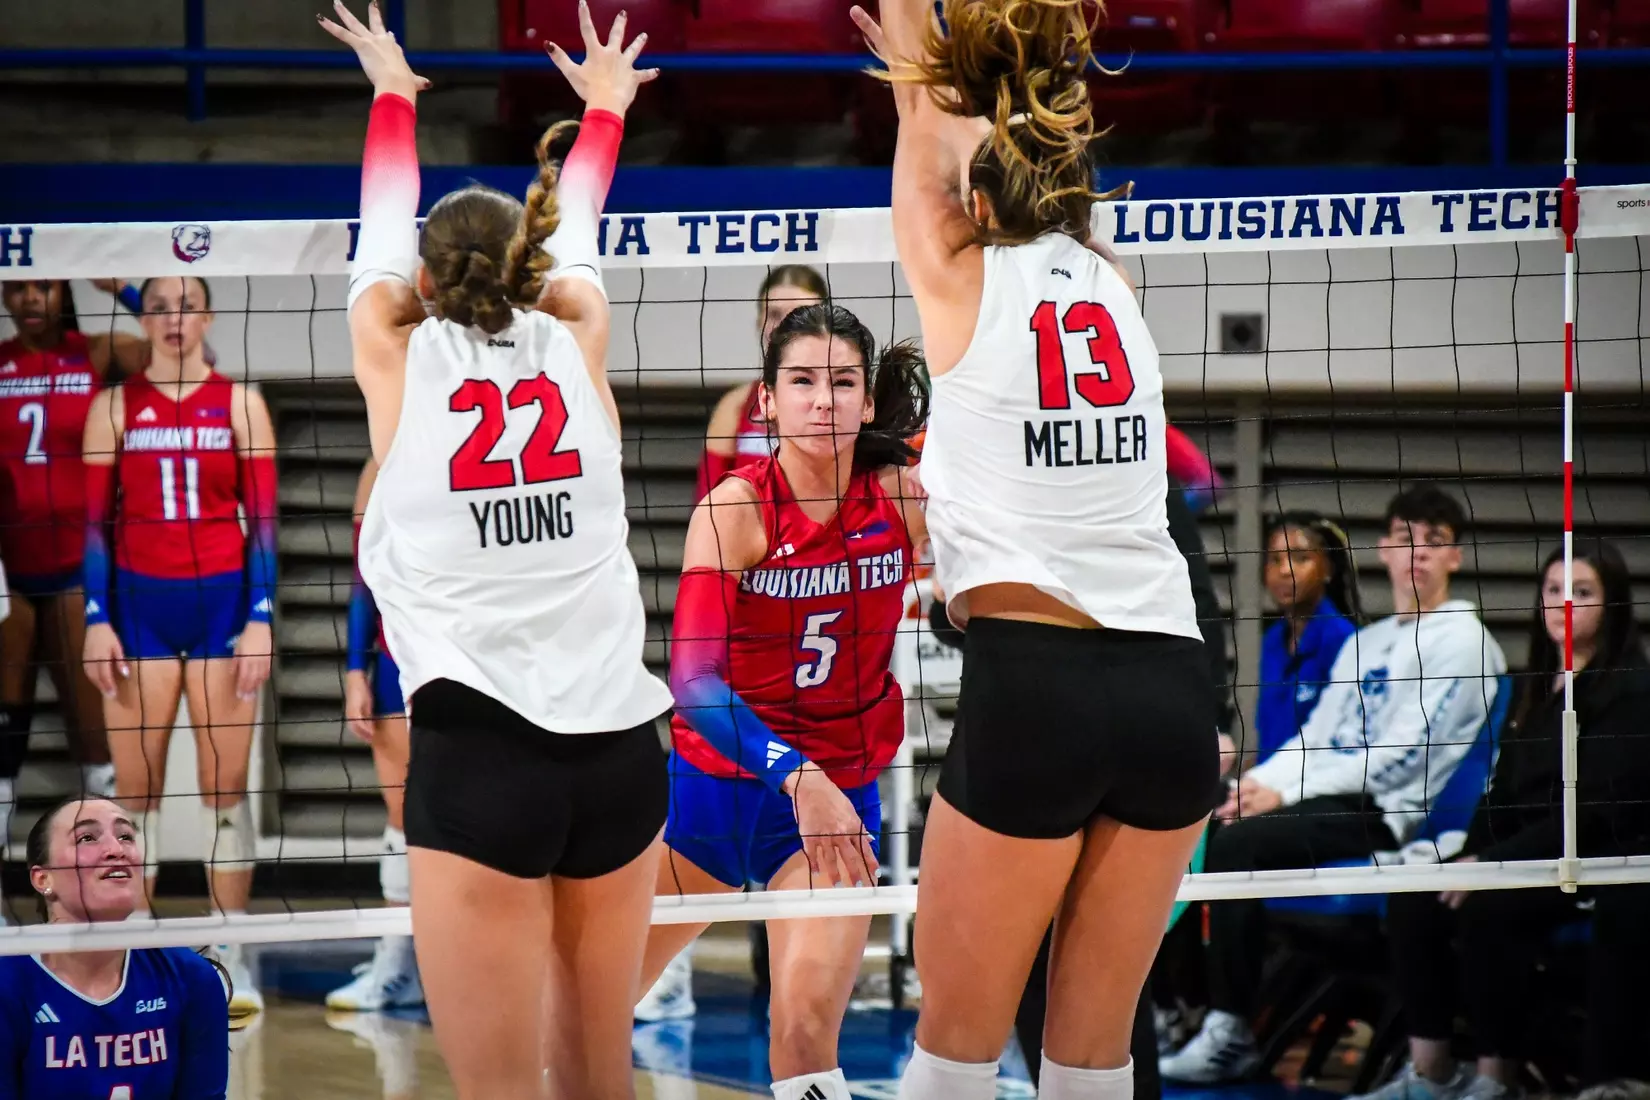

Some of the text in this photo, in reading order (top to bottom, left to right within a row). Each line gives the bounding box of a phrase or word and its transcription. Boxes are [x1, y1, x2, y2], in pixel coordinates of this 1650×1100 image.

[1113, 190, 1562, 243] LOUISIANA TECH
[1616, 198, 1646, 209] sports
[0, 227, 33, 267] H
[678, 212, 819, 254] TECH
[1029, 300, 1135, 410] 13
[19, 402, 47, 465] 2
[449, 371, 582, 492] 22
[1024, 415, 1147, 467] MELLER
[159, 457, 200, 520] 11
[469, 491, 573, 548] YOUNG
[741, 548, 904, 598] LOUISIANA TECH
[795, 610, 843, 688] 5
[45, 1028, 168, 1068] LA TECH
